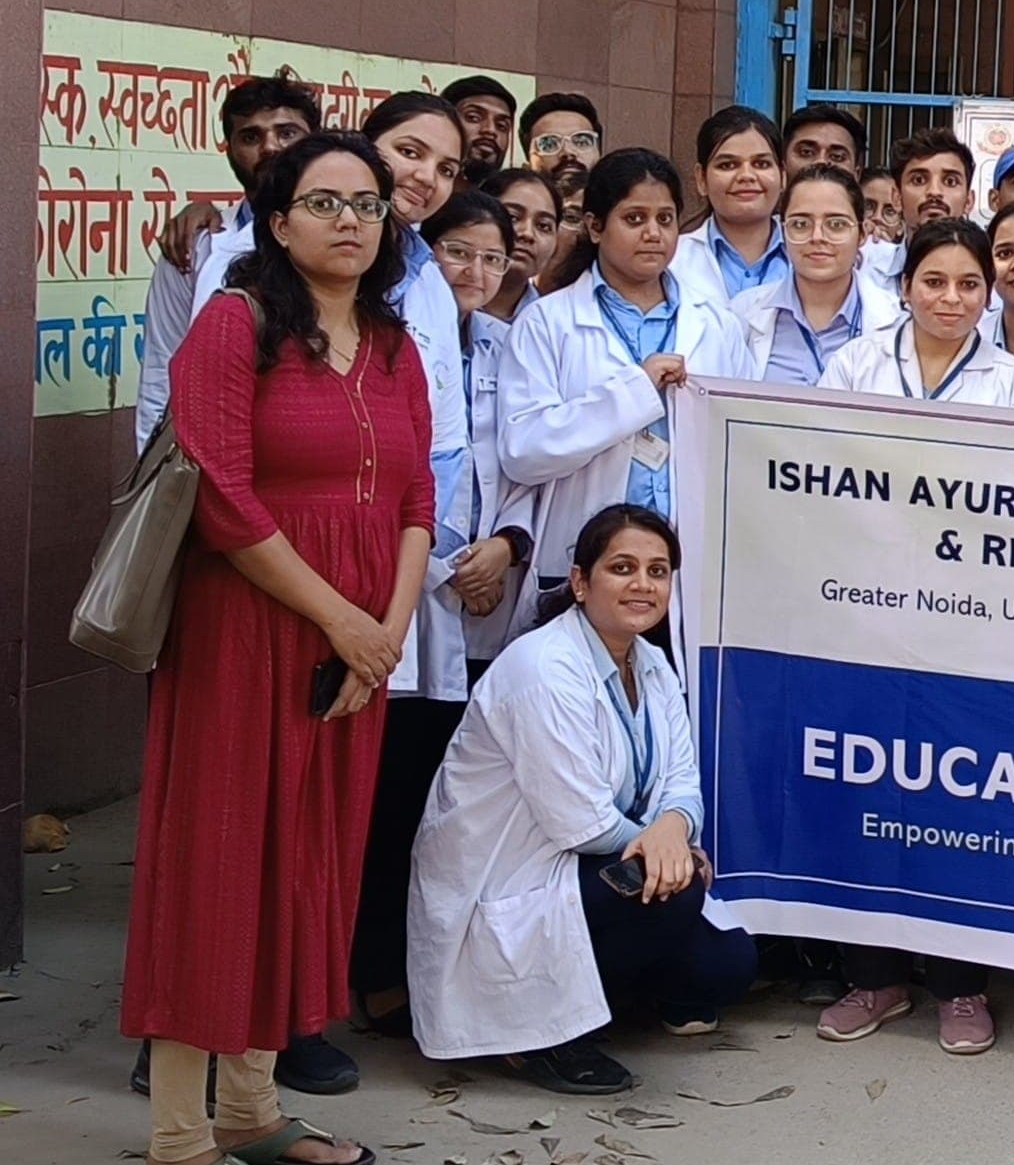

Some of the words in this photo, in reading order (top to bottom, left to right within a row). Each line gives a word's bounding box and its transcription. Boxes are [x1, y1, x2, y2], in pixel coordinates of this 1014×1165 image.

[97, 60, 211, 153] स्वच्छता
[82, 295, 127, 379] की
[768, 459, 890, 502] ISHAN
[935, 529, 963, 562] &
[821, 579, 908, 609] Greater
[916, 589, 993, 622] Noida,
